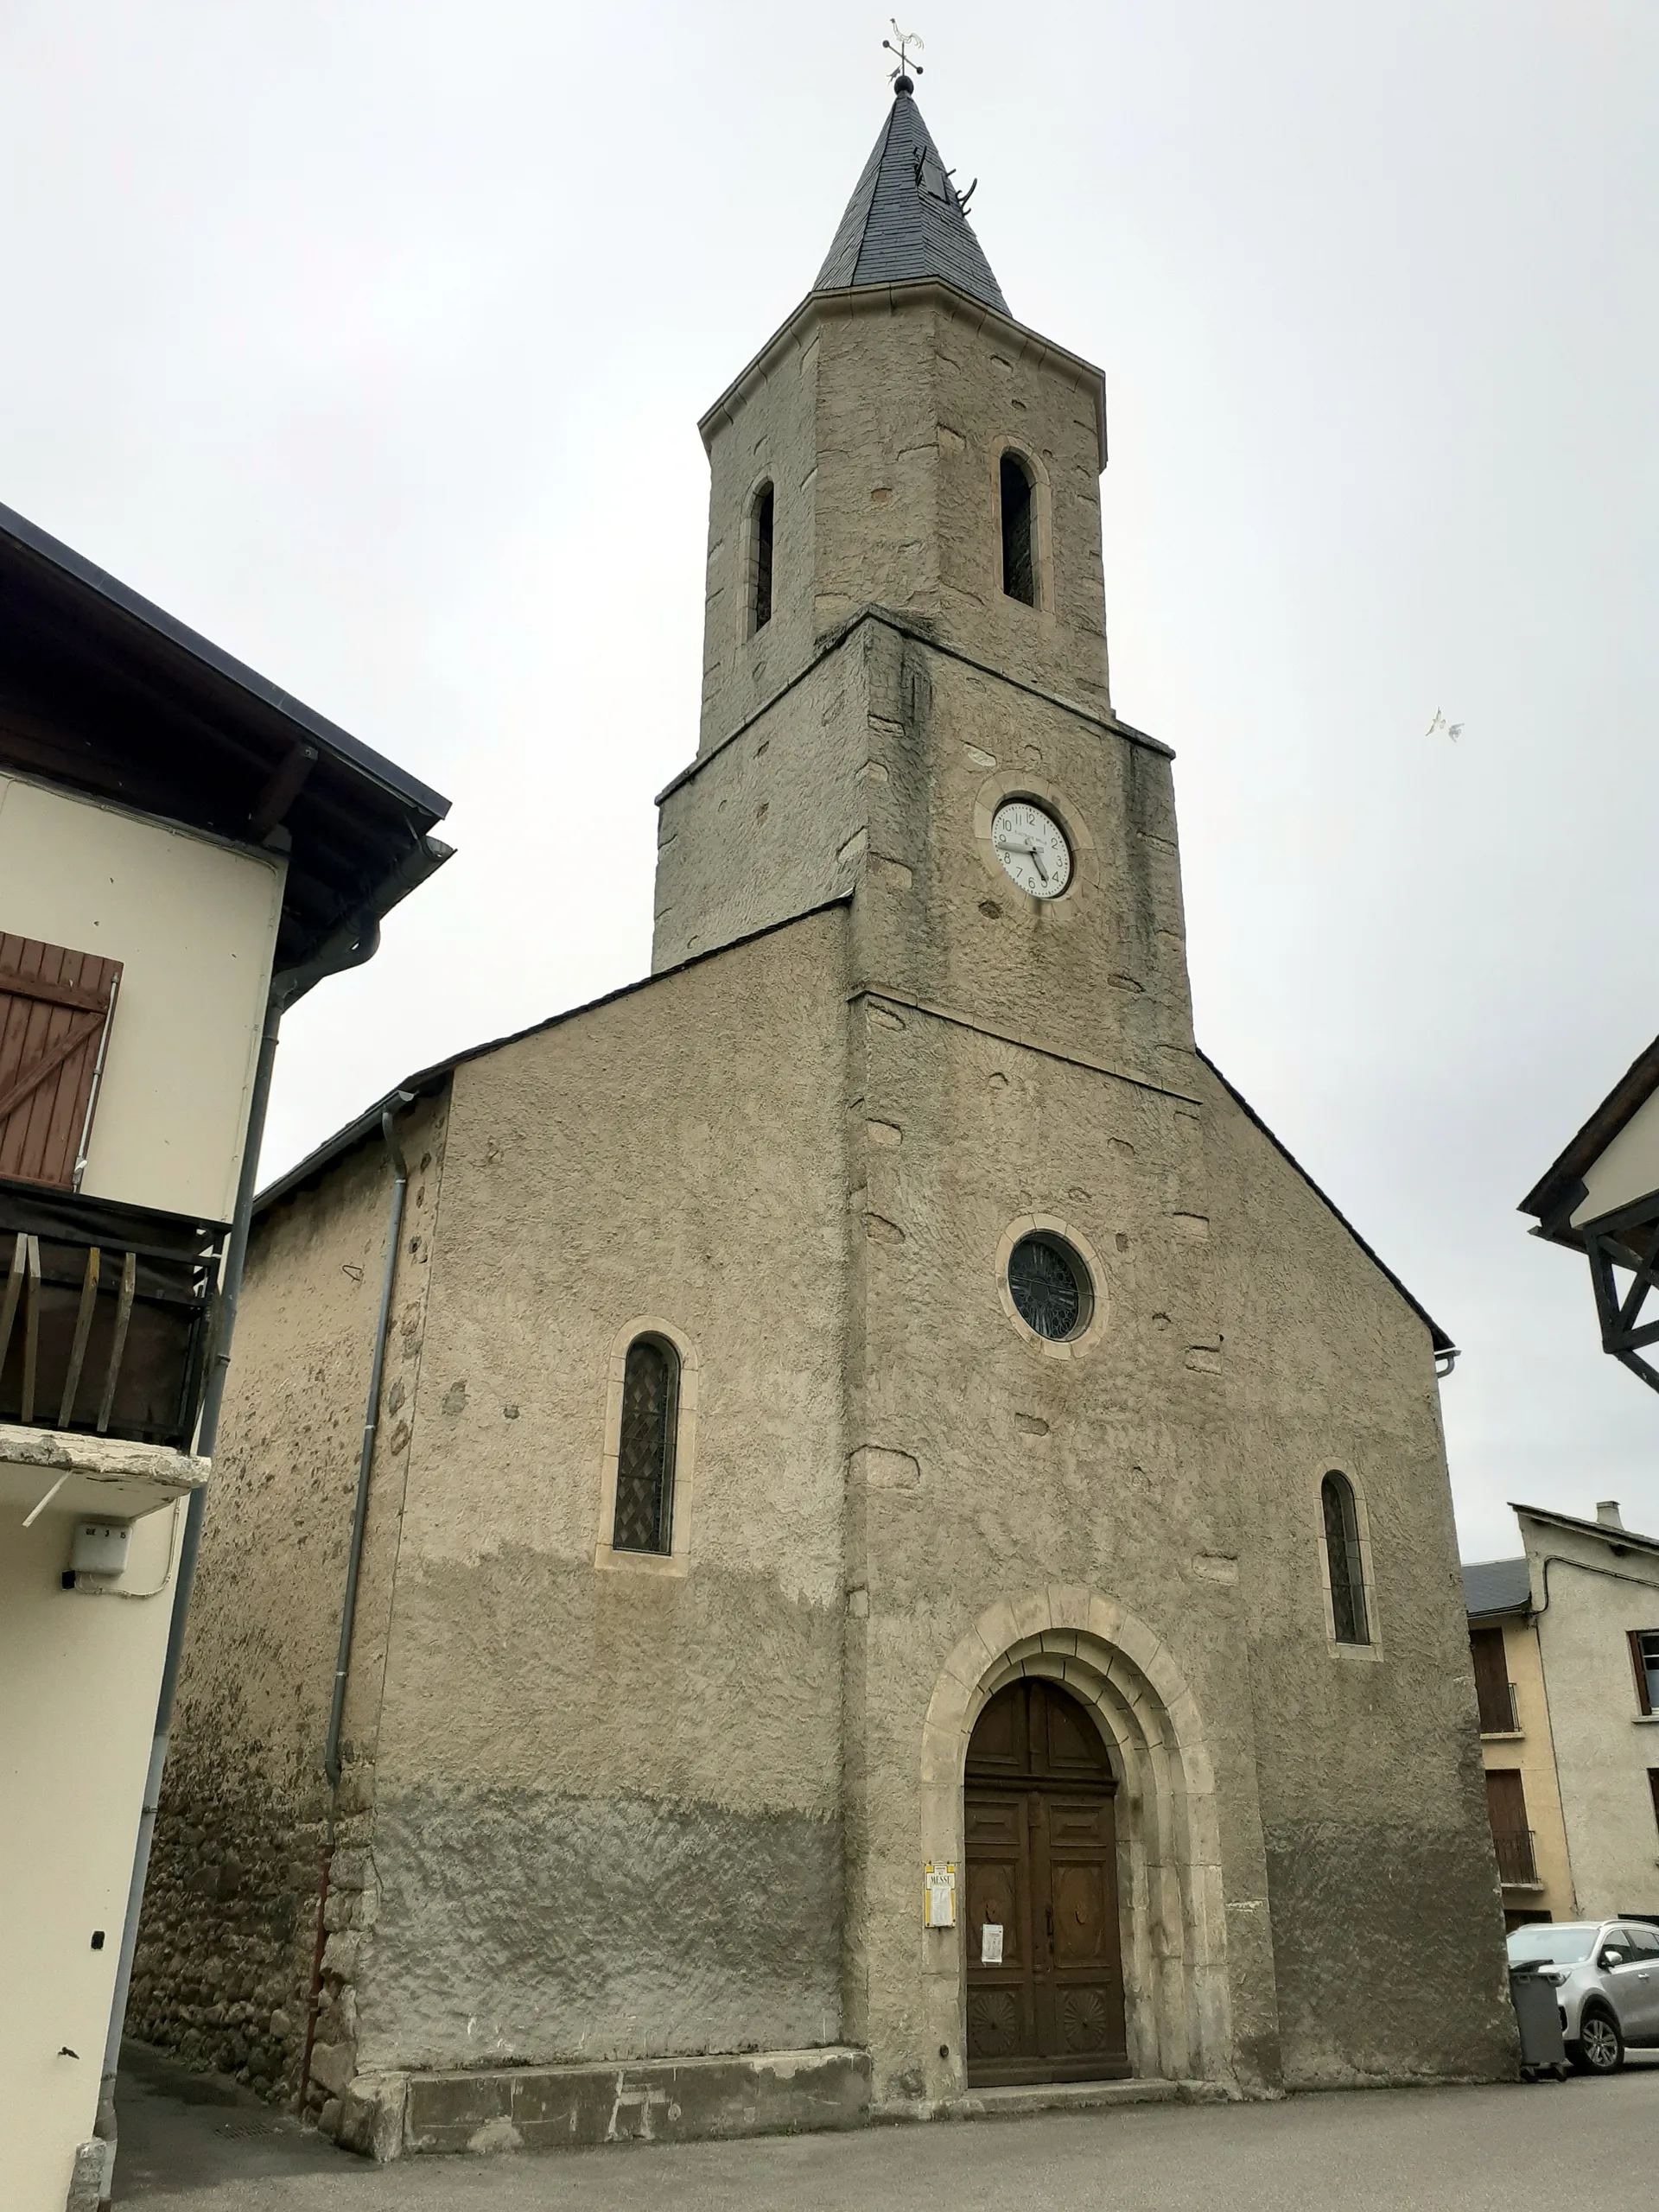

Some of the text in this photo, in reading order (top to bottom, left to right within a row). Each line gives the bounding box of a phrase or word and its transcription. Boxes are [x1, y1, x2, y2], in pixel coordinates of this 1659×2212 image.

[1002, 818, 1012, 831] 10
[1015, 812, 1022, 826] 11
[1026, 812, 1036, 826] 12
[999, 834, 1007, 842] 9
[1051, 837, 1058, 849] 2
[1003, 852, 1012, 864] 8
[1056, 855, 1063, 868] 3
[1016, 867, 1023, 878] 7
[1052, 871, 1059, 882] 4
[1028, 877, 1036, 889] 6
[930, 1875, 950, 1885] MESSE
